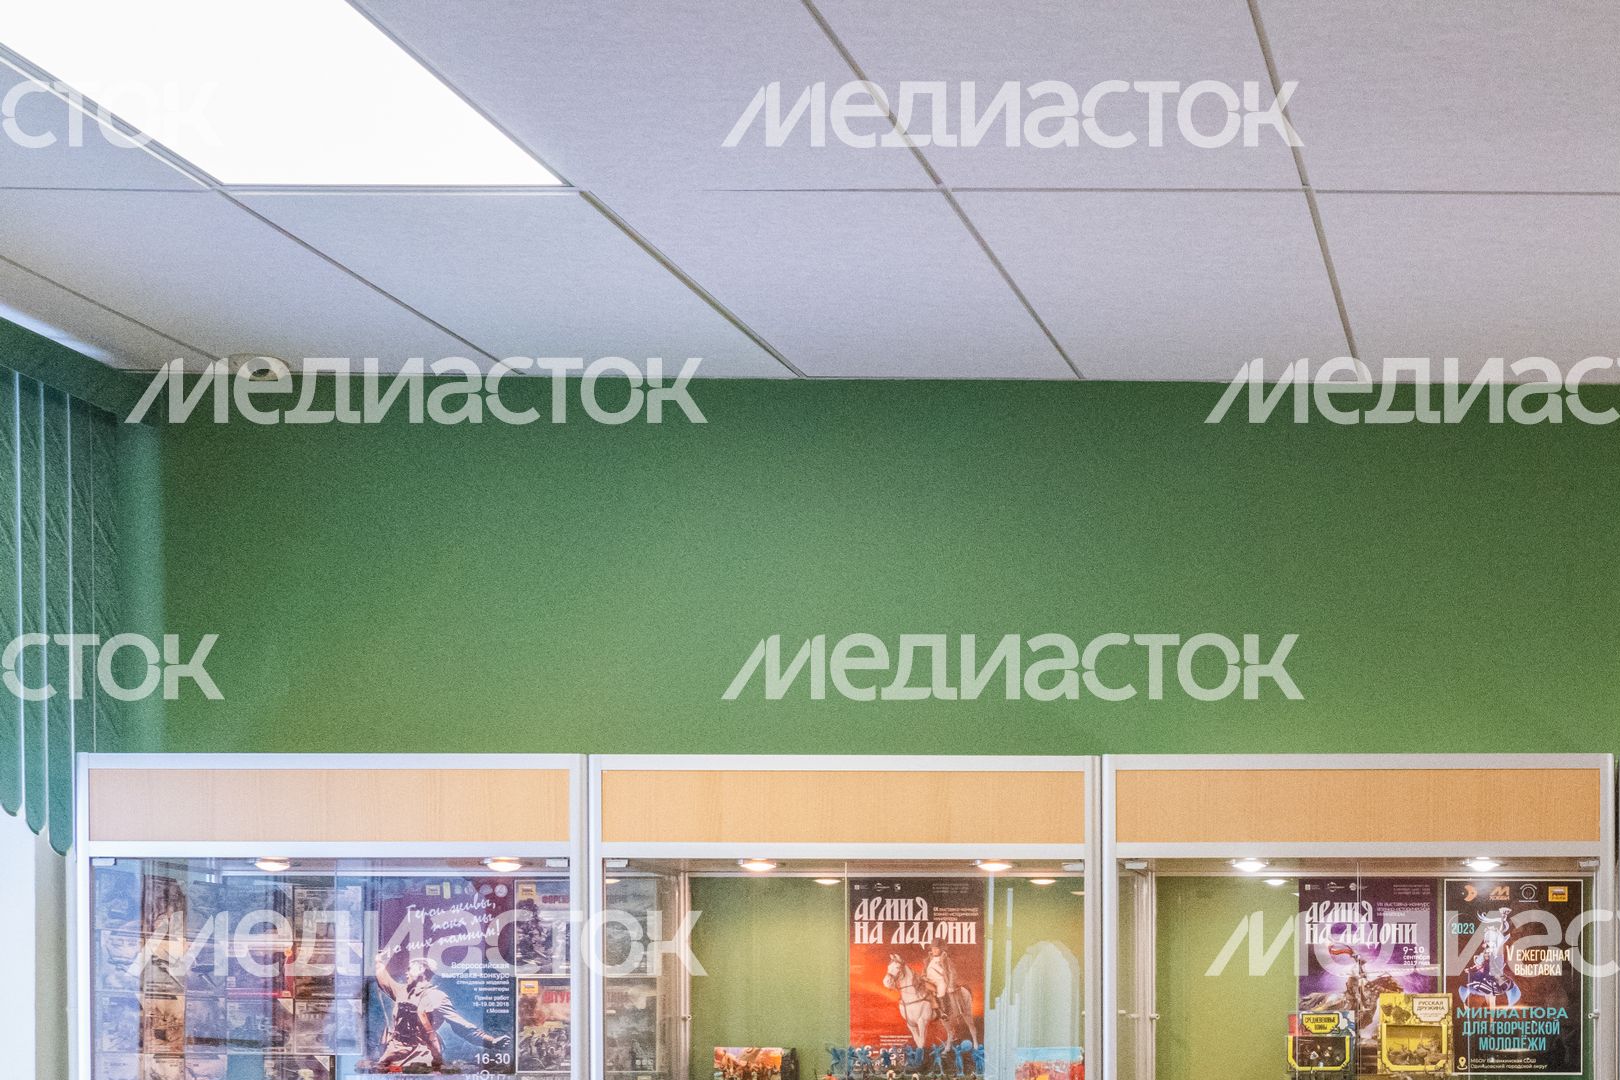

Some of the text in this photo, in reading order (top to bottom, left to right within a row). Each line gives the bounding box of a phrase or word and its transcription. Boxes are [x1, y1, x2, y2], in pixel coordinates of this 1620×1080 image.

[854, 896, 929, 921] АРМИЯ
[1305, 900, 1374, 923] АРМИЯ
[854, 921, 977, 950] НА ЛАДОНИ
[1451, 922, 1475, 934] 2023
[1305, 923, 1418, 949] НА ЛАДОНИ
[1402, 946, 1425, 954] 9-10
[1506, 945, 1571, 961] V ЕЖЕГОДНАЯ
[1514, 963, 1562, 976] ВЫСТАВКА
[1456, 1007, 1568, 1019] МИНИАТЮРА
[1462, 1020, 1560, 1036] ДЛЯ ТВОРЧЕСКОЙ
[1479, 1036, 1547, 1051] МОЛОДЁЖИ
[475, 1053, 511, 1065] 16-30
